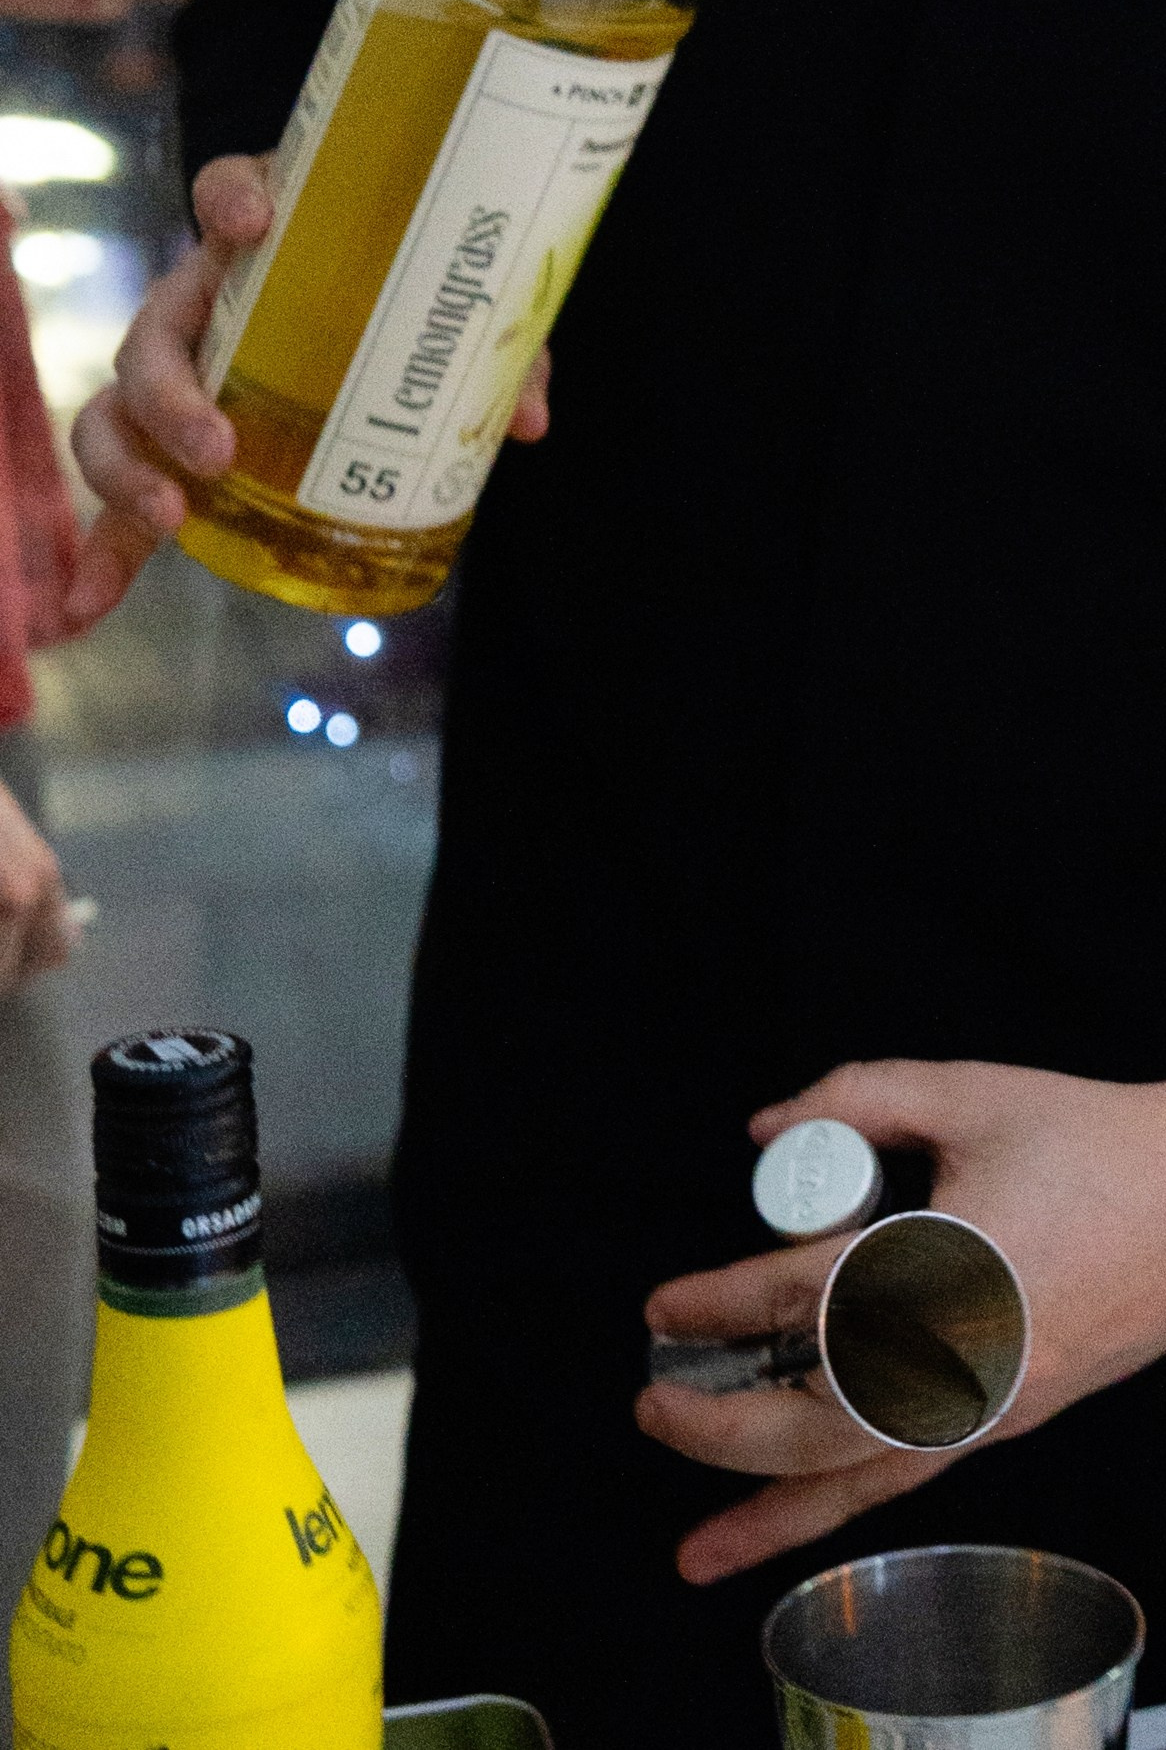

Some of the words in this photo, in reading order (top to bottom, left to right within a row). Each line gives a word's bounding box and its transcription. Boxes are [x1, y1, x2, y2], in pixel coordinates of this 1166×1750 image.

[366, 204, 510, 437] Lemongrass
[340, 459, 401, 502] 55
[45, 1517, 165, 1601] one
